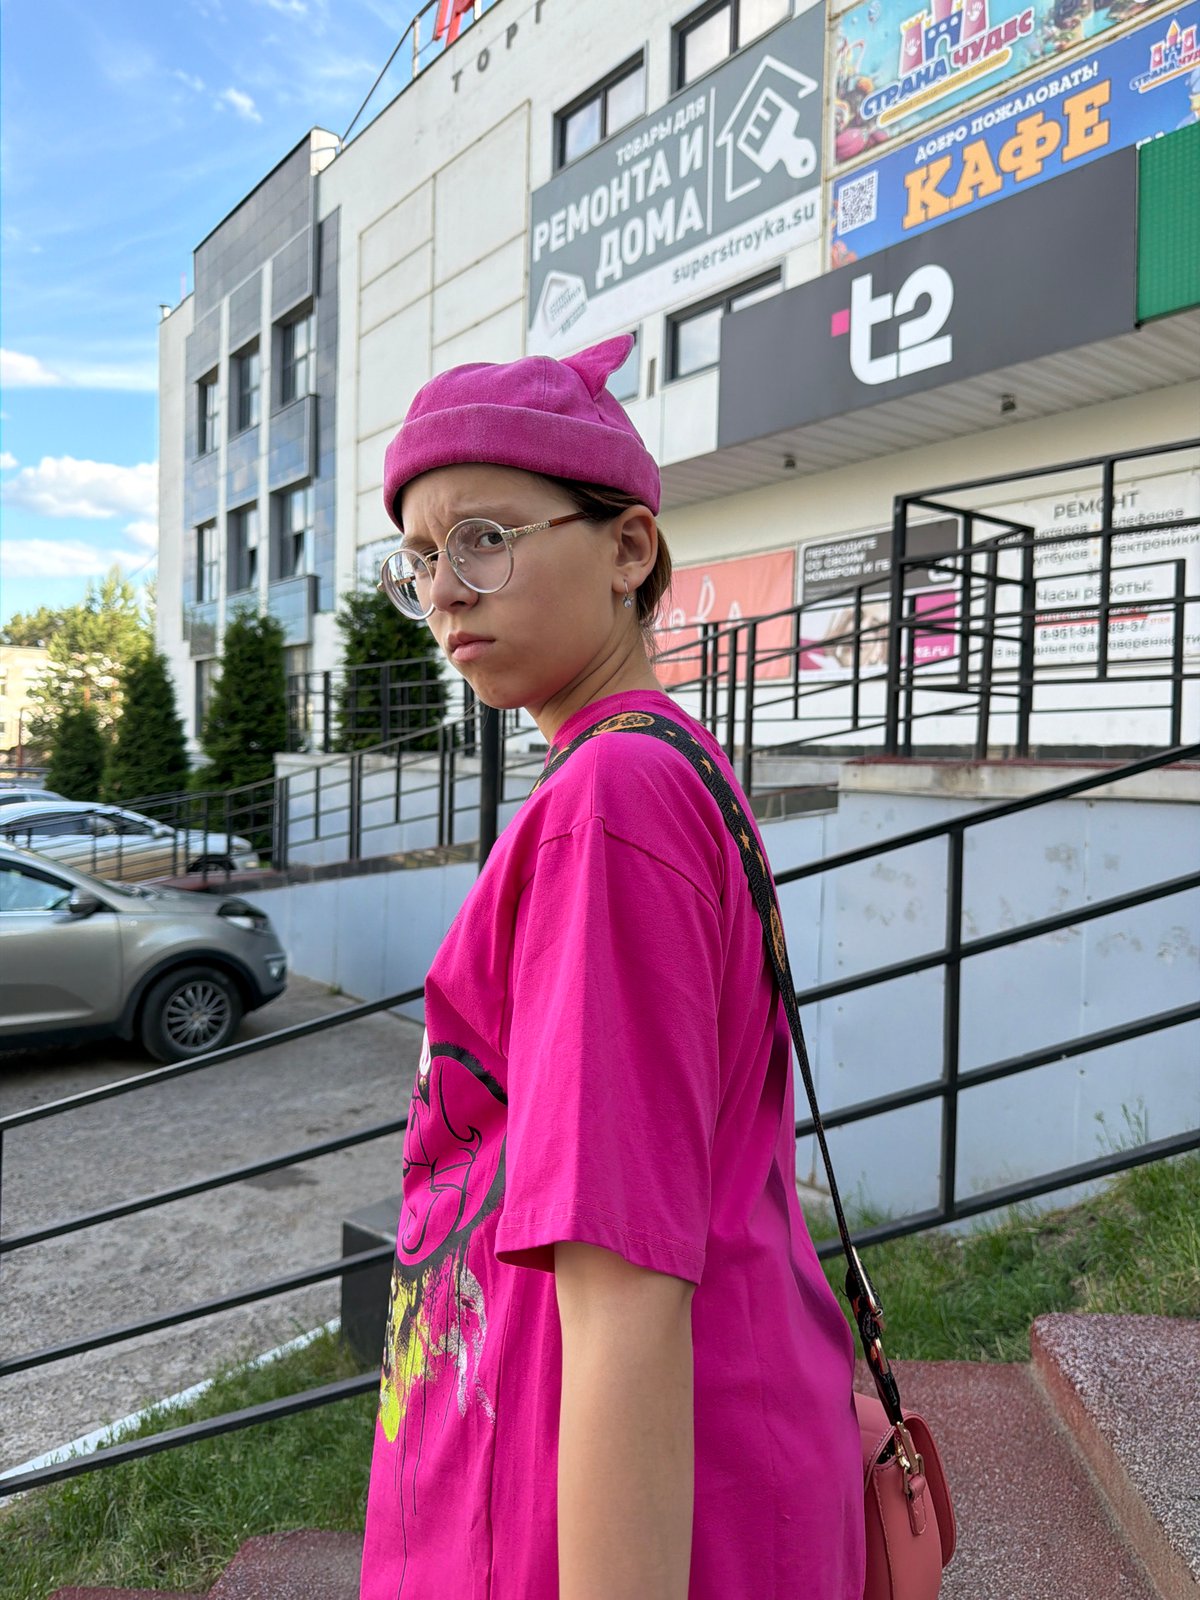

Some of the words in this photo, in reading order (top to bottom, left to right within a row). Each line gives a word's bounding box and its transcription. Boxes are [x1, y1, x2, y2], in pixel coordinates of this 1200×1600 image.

[862, 57, 948, 117] СТРАНА
[953, 9, 1033, 66] ЧУДЕС
[915, 125, 967, 164] ДОБРО
[971, 60, 1099, 135] ПОЖАЛОВАТЬ!
[615, 116, 672, 166] ТОВАРЫ
[673, 95, 706, 134] ДЛЯ
[902, 79, 1111, 231] КАФЕ
[532, 149, 671, 263] РЕМОНТА
[679, 125, 703, 178] И
[595, 186, 704, 289] ДОМА
[673, 202, 815, 284] superstroyka.su
[849, 263, 954, 385] t2
[805, 564, 862, 583] НОМЕРОМ
[1084, 580, 1153, 601] раоты:
